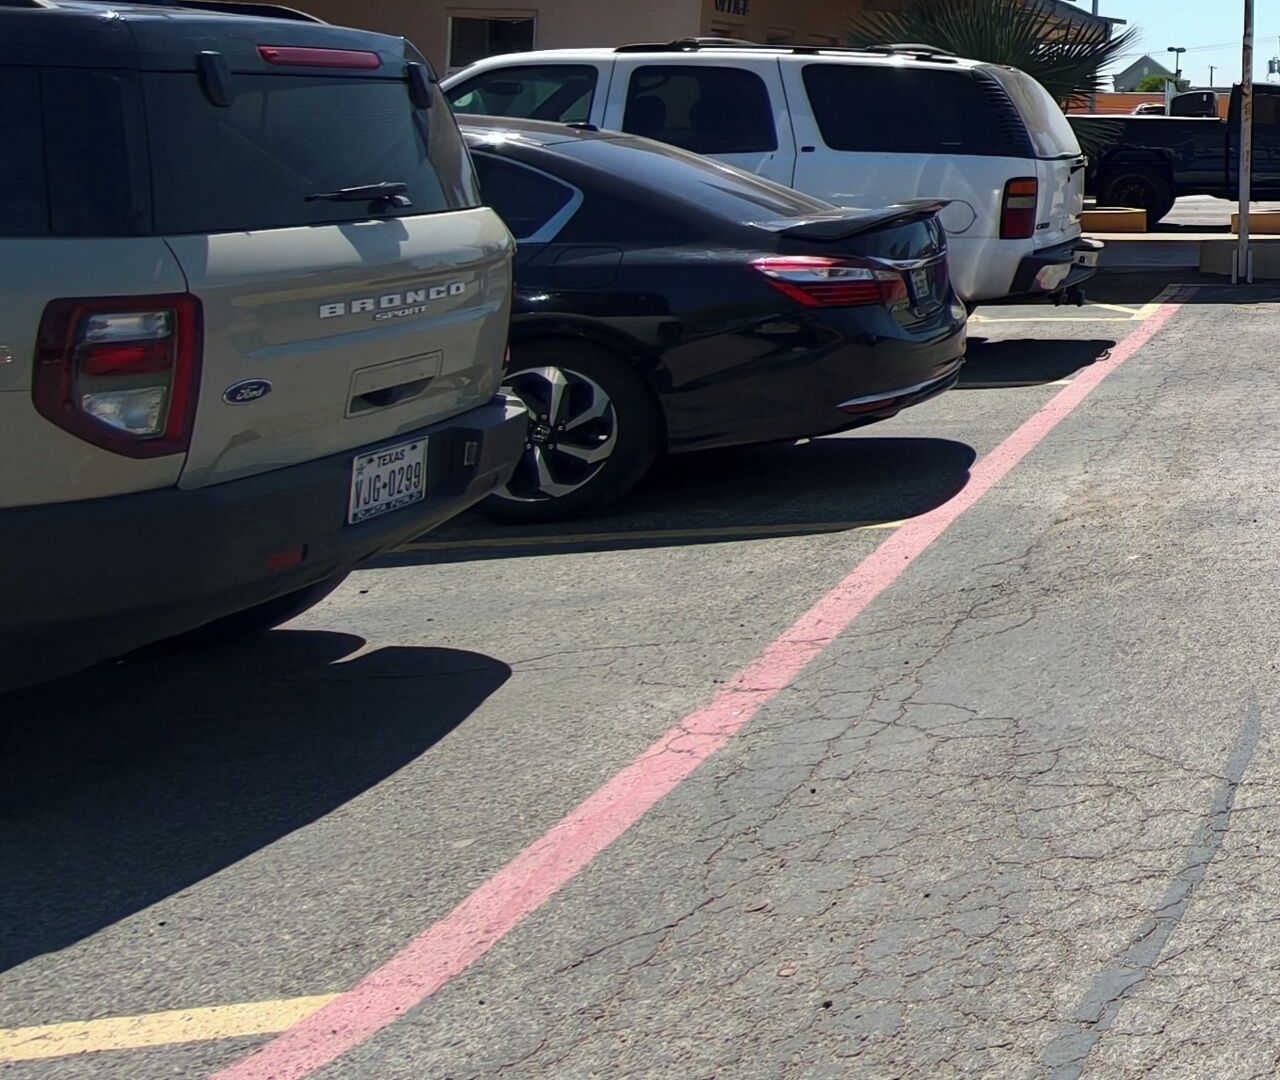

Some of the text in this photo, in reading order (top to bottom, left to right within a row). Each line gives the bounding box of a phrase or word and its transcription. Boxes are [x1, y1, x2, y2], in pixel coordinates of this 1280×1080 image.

[319, 281, 466, 318] BRONCO
[375, 304, 427, 321] SPORT
[376, 449, 406, 468] TEXAS
